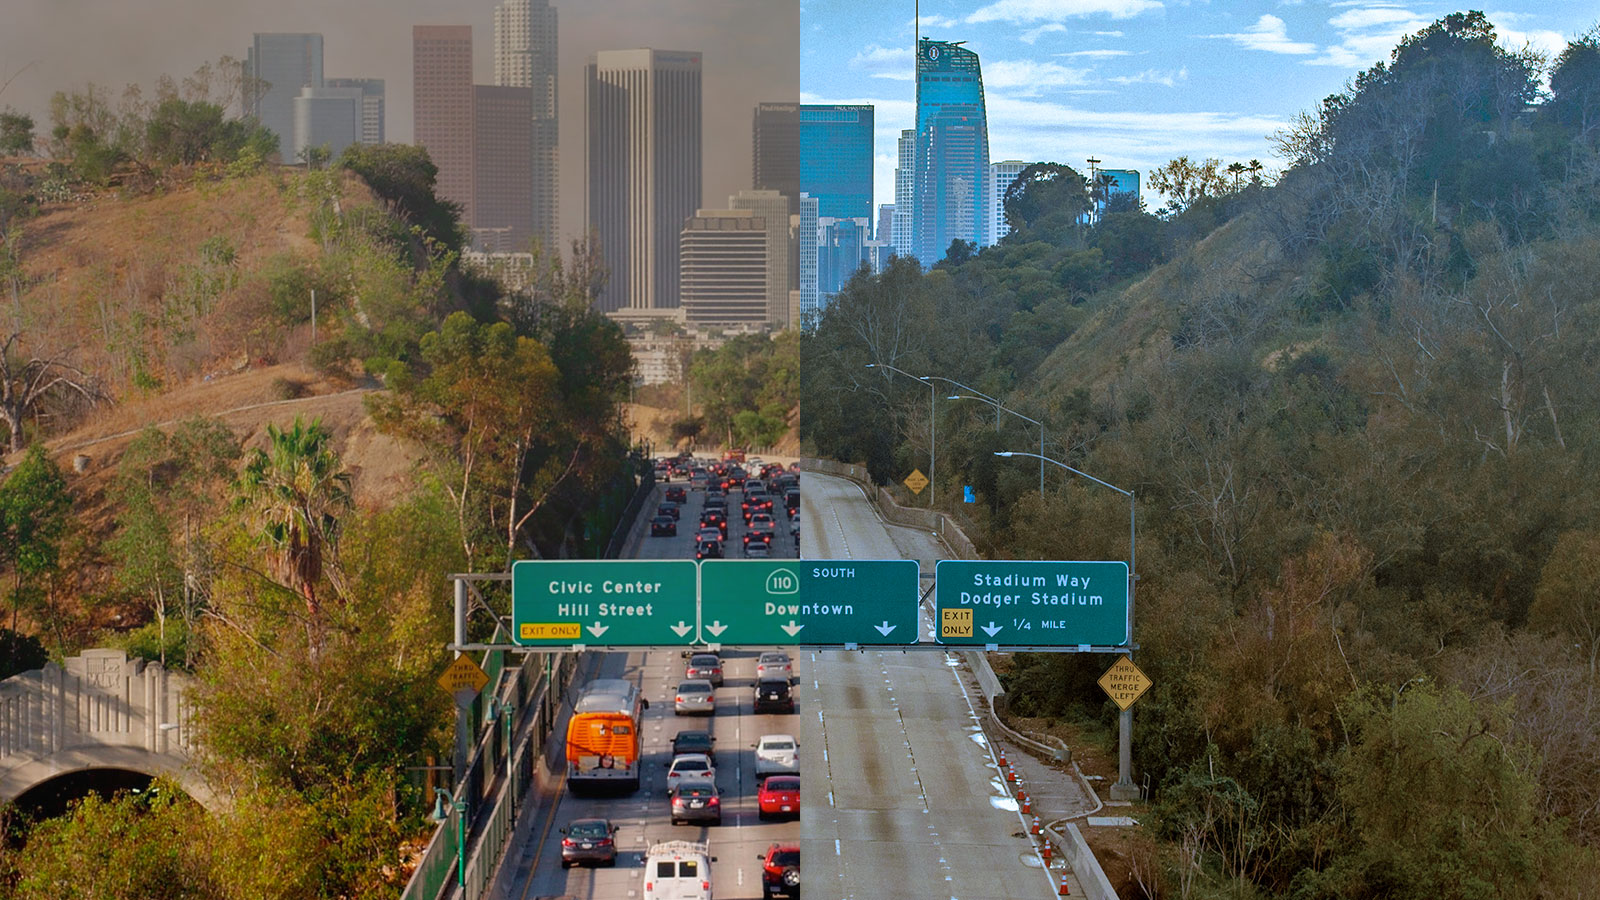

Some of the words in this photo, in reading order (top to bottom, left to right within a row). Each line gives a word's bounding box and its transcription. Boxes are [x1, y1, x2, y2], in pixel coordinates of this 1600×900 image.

[812, 567, 856, 578] SOUTH
[772, 576, 792, 589] 110
[973, 573, 1047, 587] Stadium
[1056, 574, 1091, 589] Way
[548, 580, 593, 594] Civic
[602, 580, 662, 594] Center
[960, 591, 1021, 608] Dodger
[1031, 592, 1103, 606] Stadium
[557, 603, 589, 617] Hill
[598, 603, 653, 616] Street
[764, 602, 854, 616] Downtown
[944, 611, 971, 621] EXIT
[943, 625, 971, 635] ONLY
[1041, 620, 1066, 629] MILE
[521, 626, 545, 636] EXIT
[551, 626, 580, 636] ONLY
[449, 672, 480, 680] TRAFFIC
[1109, 674, 1140, 682] TRAFFIC
